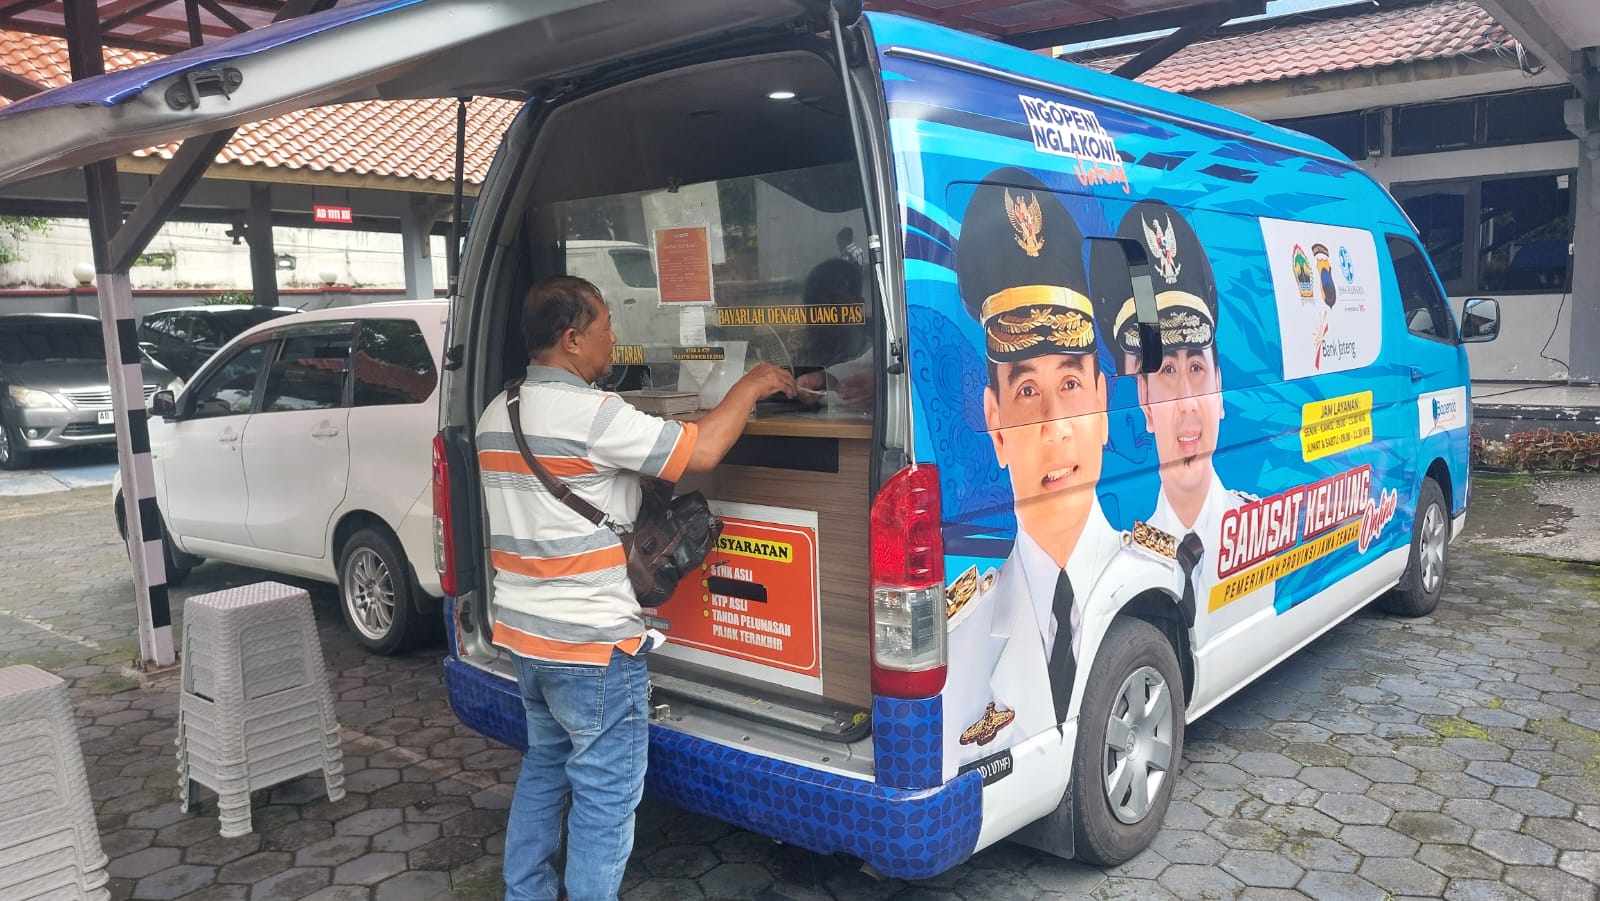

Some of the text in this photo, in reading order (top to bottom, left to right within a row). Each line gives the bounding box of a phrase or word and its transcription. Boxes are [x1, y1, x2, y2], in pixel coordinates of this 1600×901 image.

[717, 308, 765, 325] BAYARLAH
[767, 307, 807, 324] DENGAN
[809, 306, 839, 324] UANG
[841, 305, 863, 323] PAS
[611, 345, 644, 364] AFTARAN
[1321, 338, 1338, 357] Bank
[1320, 404, 1333, 419] JAM
[1219, 468, 1371, 574] SAMSAT KELILING
[1224, 523, 1360, 601] PEMERINTAH PROVINSI JAWA TENGAH
[710, 564, 753, 582] STNK ASLI
[711, 593, 748, 612] KTP ASLI
[711, 608, 791, 637] TANDA PELUNASAN
[712, 624, 783, 652] PAJAK TERAKHIR
[986, 756, 1011, 777] LUTHFI
